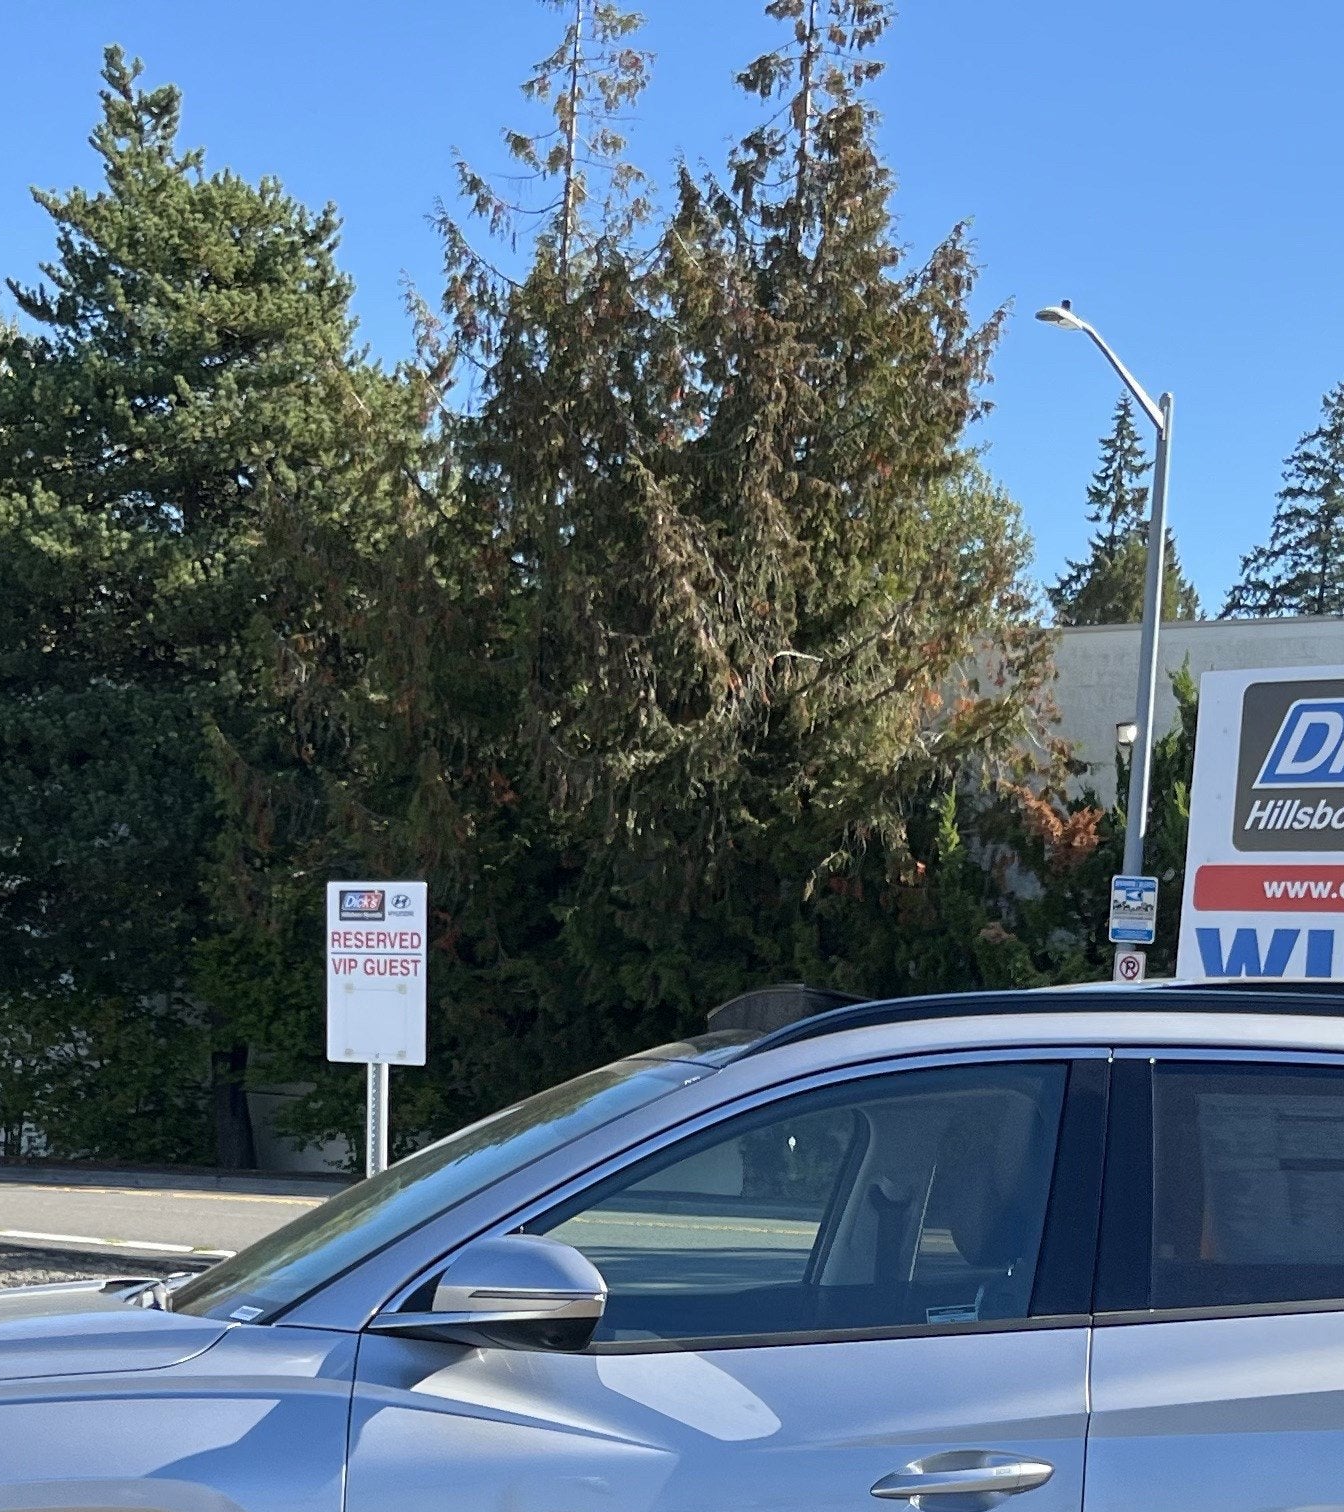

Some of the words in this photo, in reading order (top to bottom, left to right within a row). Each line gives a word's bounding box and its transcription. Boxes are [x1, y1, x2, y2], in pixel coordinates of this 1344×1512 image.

[331, 931, 422, 949] RESERVED
[331, 958, 358, 976] VIP
[364, 958, 422, 977] GUEST
